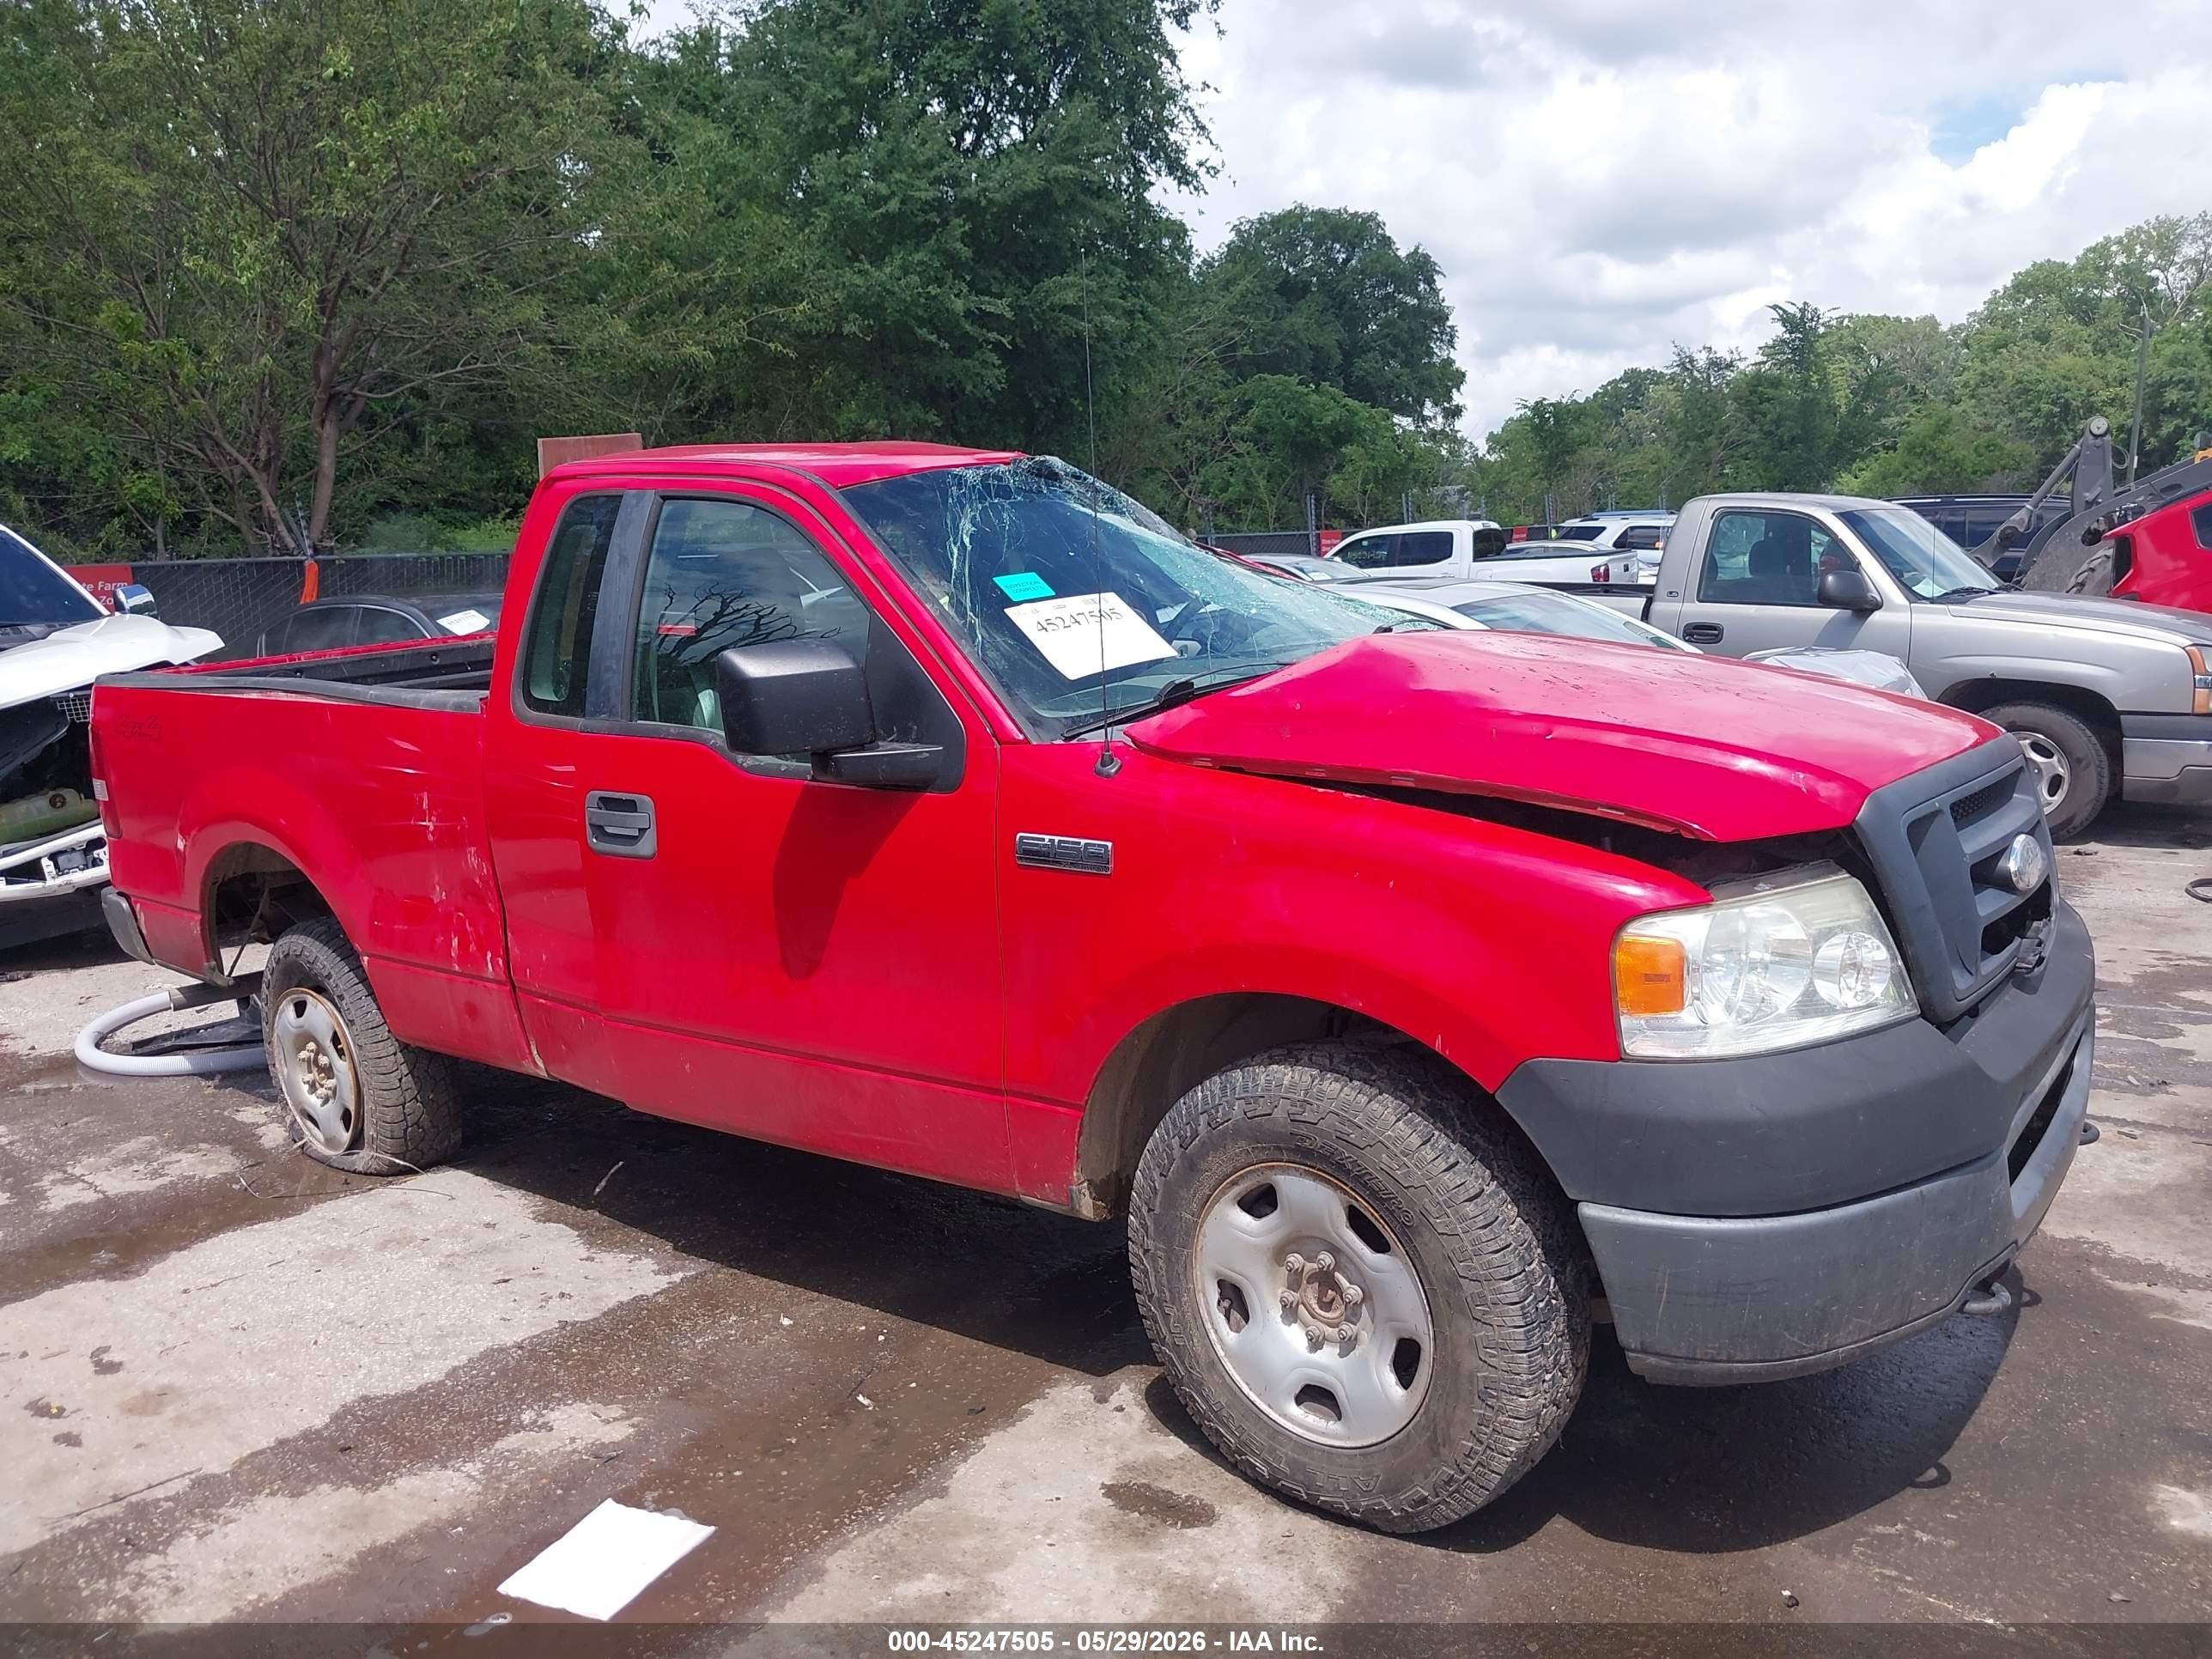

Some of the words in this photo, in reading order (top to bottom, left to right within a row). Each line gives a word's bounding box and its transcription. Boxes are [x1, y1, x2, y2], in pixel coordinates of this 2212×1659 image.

[1004, 580, 1042, 590] INSPECTION
[1036, 608, 1123, 632] 45247505
[1306, 1466, 1382, 1493] ALL
